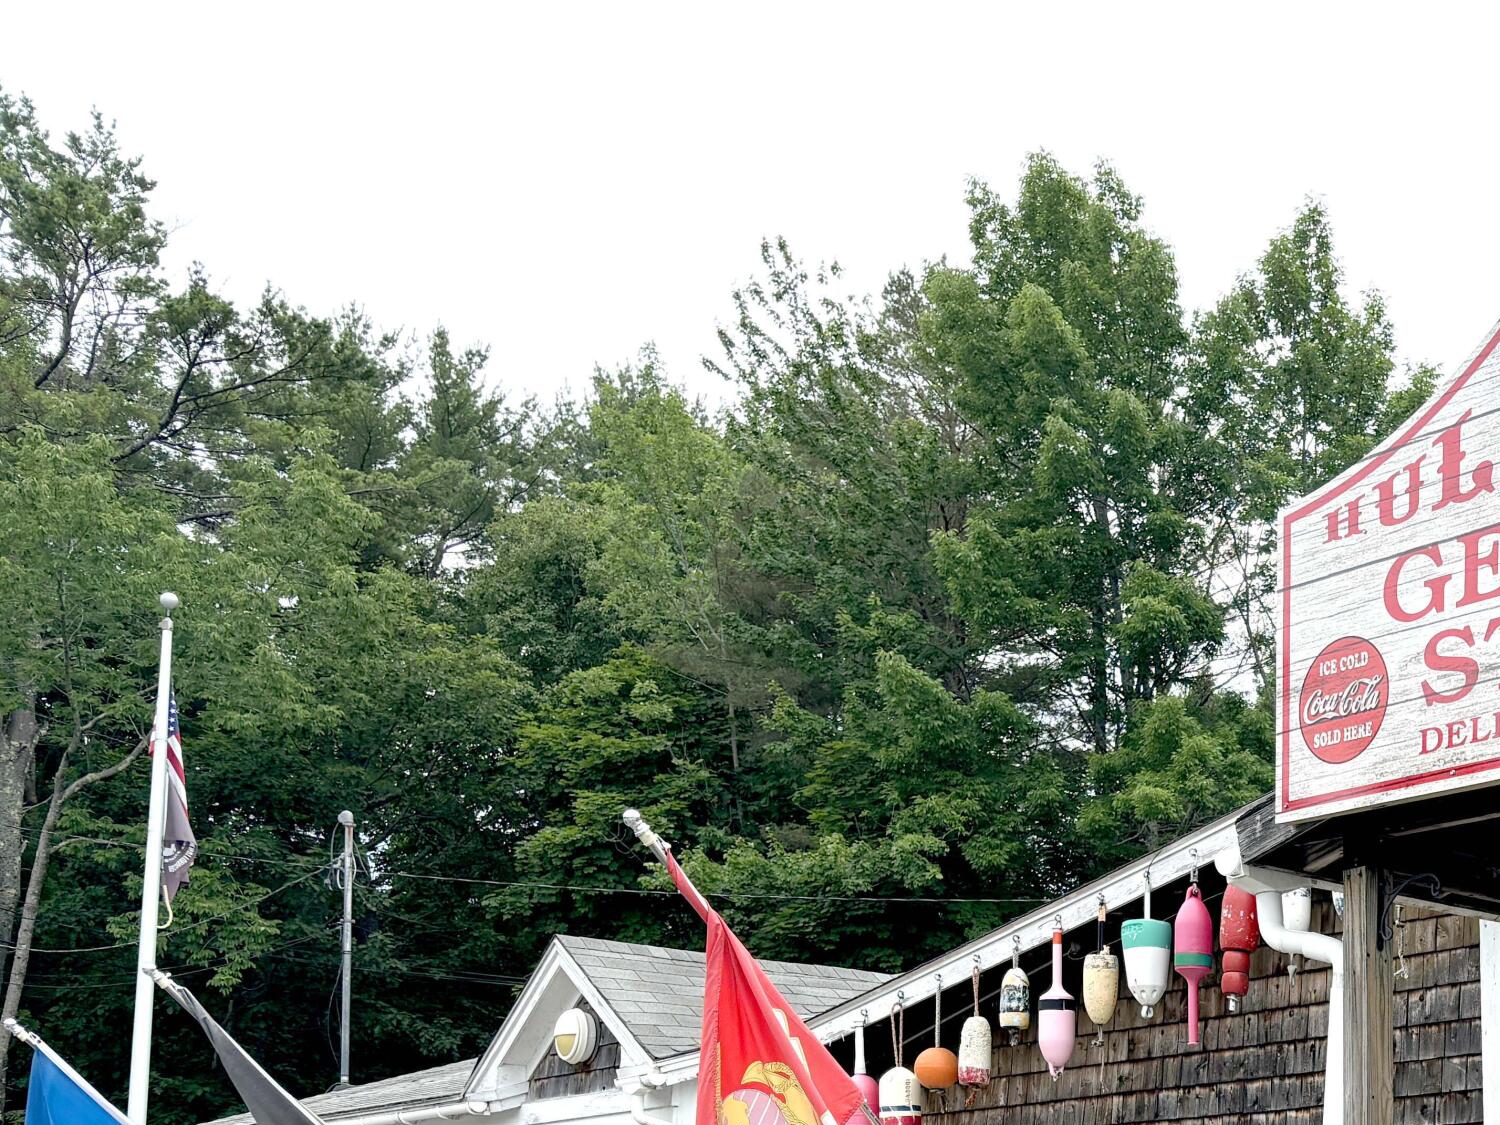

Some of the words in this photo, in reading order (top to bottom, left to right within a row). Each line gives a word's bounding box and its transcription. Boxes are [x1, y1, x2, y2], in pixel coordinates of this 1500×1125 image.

[1319, 659, 1338, 677] ICE
[1339, 651, 1369, 672] COLD
[1303, 674, 1384, 725] Coca-Cola
[1313, 729, 1341, 749] SOLD
[1343, 721, 1373, 742] HERE
